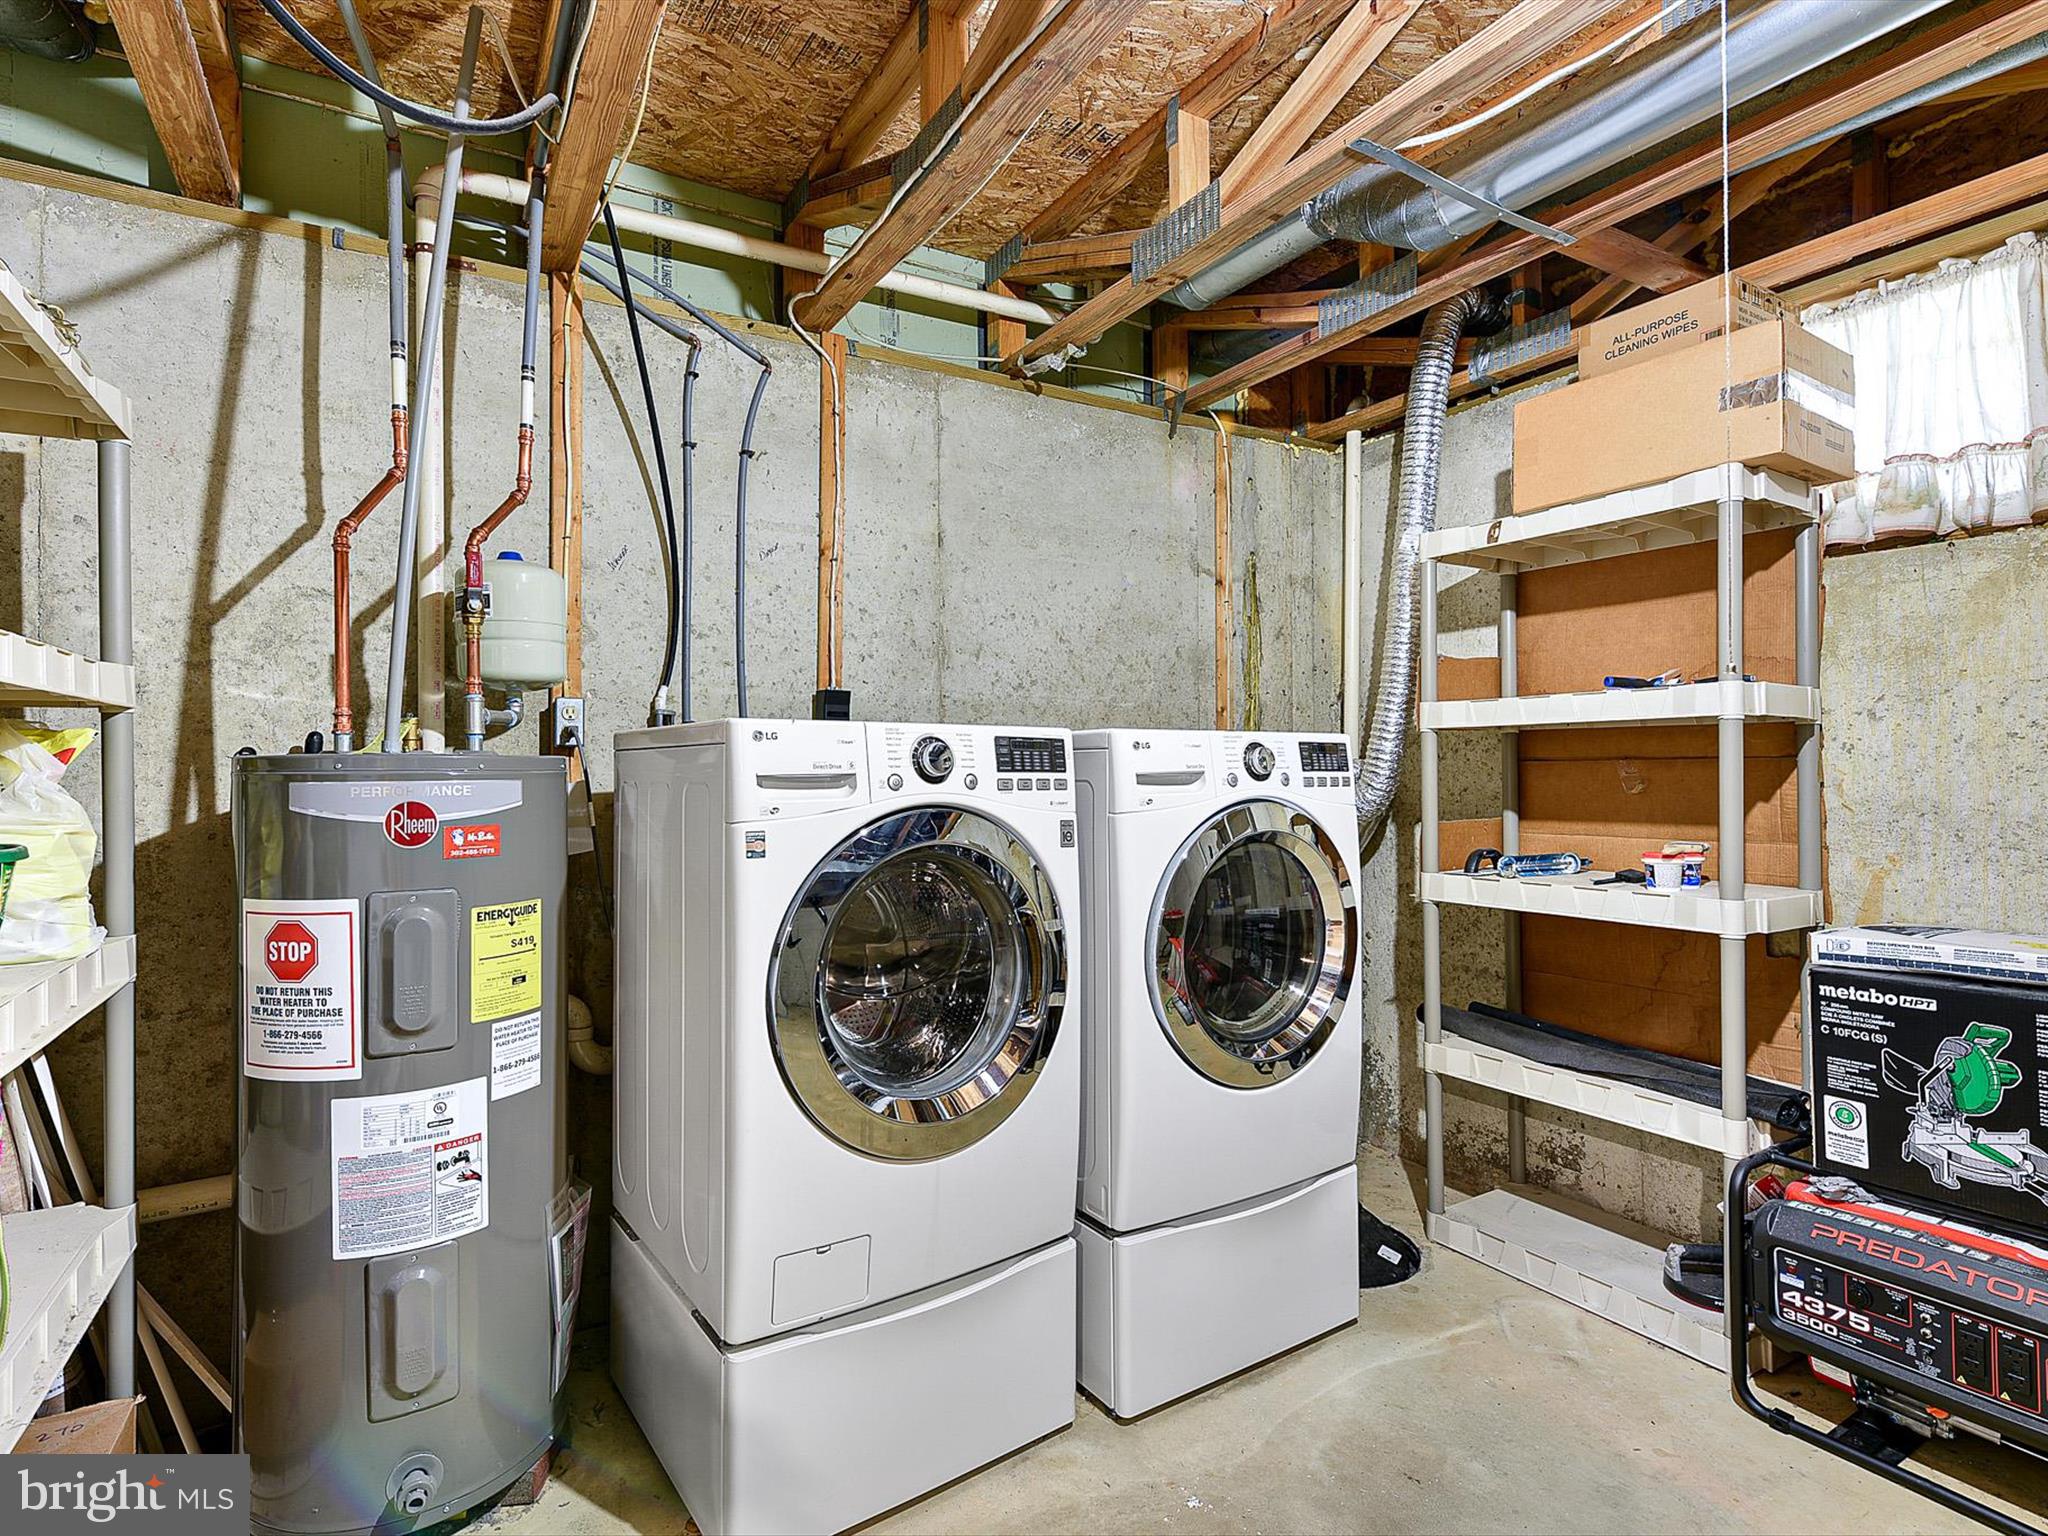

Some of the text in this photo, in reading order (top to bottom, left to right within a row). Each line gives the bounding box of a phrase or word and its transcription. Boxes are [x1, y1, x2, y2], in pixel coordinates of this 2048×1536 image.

[1612, 310, 1688, 346] ALL-PURPOSE
[1604, 320, 1698, 360] CLEANING WIPES
[766, 732, 778, 740] LG
[390, 803, 435, 840] Rheem
[477, 903, 538, 923] ENERGYGUIDE
[269, 941, 311, 962] STOP
[256, 986, 333, 996] DO NOT RETURN THIS
[1819, 985, 1898, 1006] metabo
[251, 1006, 343, 1018] THE PLACE OF PURCHASE
[260, 997, 327, 1007] WATER HEATER TO
[1902, 998, 1934, 1009] HPT
[263, 1030, 322, 1040] 1-866-279-4566
[1821, 1024, 1888, 1044] C 10FCG (S)
[446, 1134, 480, 1149] DANGER
[1810, 1222, 2048, 1306] PREDATOR
[1782, 1290, 1870, 1332] 4375
[1782, 1308, 1838, 1336] 3500
